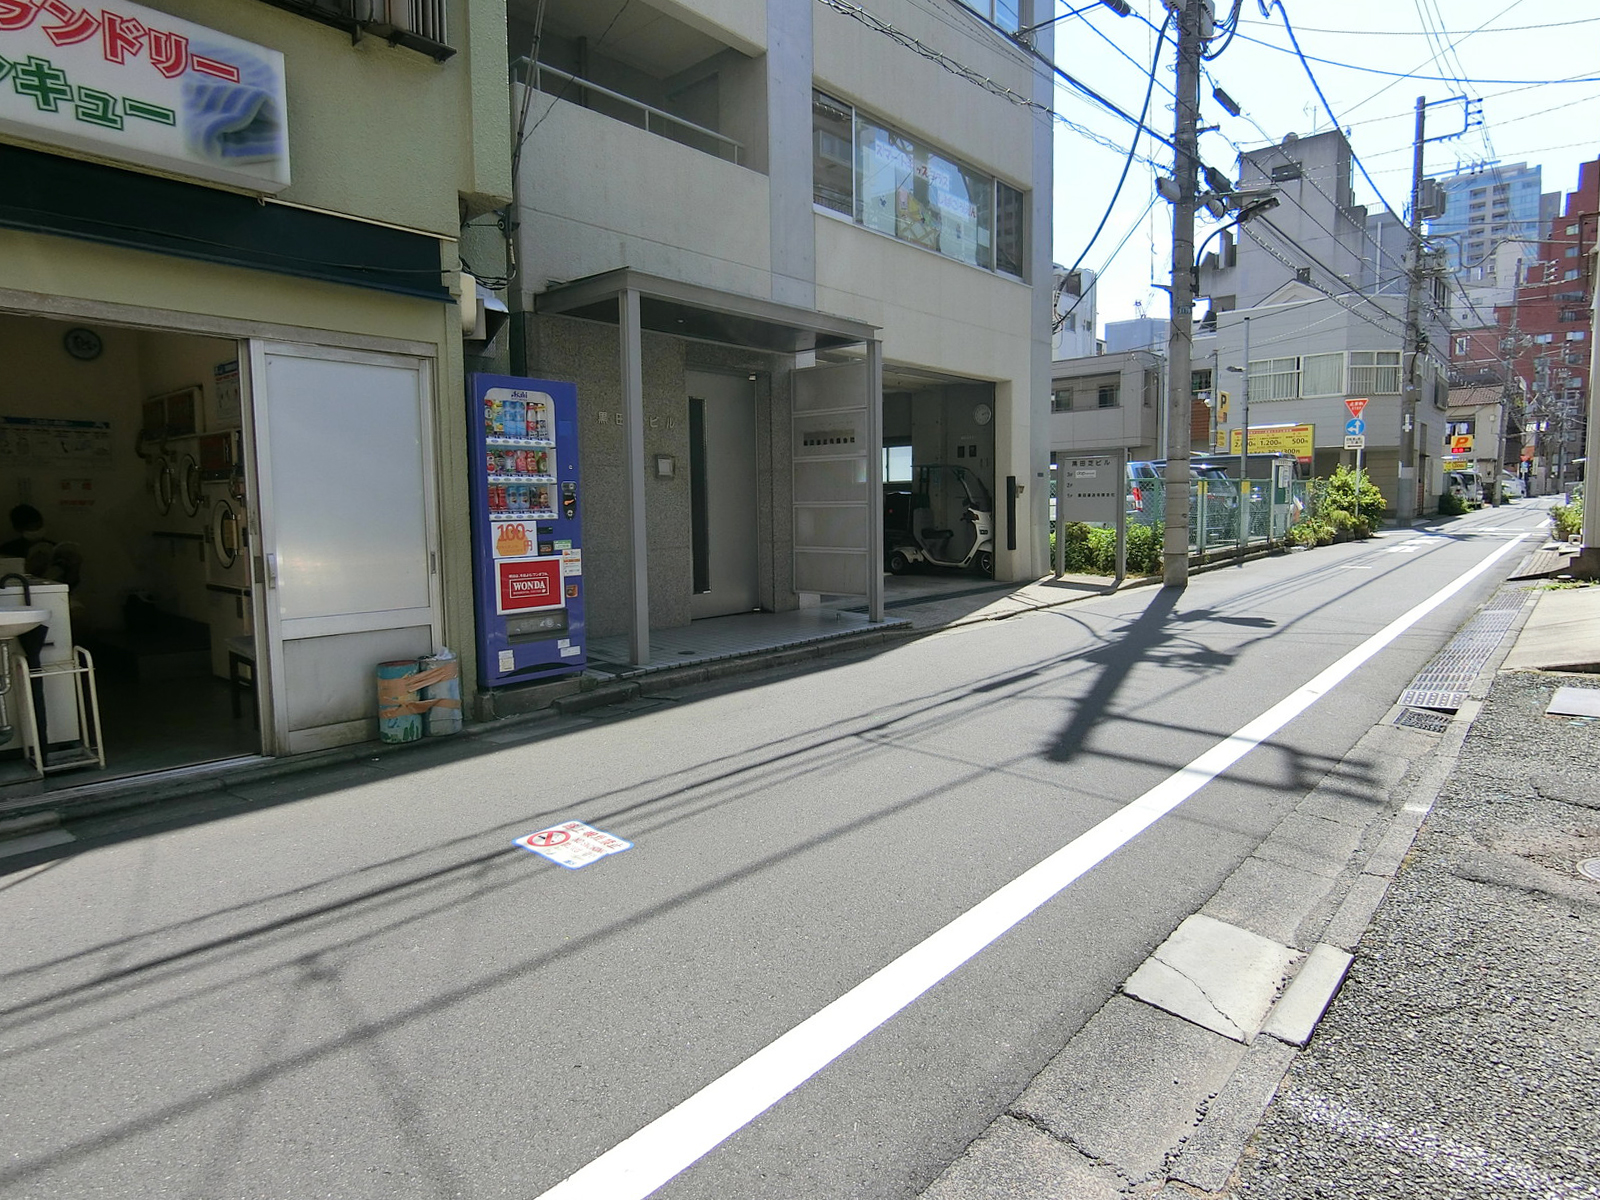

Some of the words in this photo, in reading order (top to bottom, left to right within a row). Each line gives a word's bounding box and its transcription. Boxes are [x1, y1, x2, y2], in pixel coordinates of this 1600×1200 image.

[511, 390, 528, 399] Asahi
[1220, 394, 1228, 409] P
[597, 410, 675, 429] 黒田ビル
[1455, 436, 1469, 447] P
[513, 580, 546, 591] WONDA
